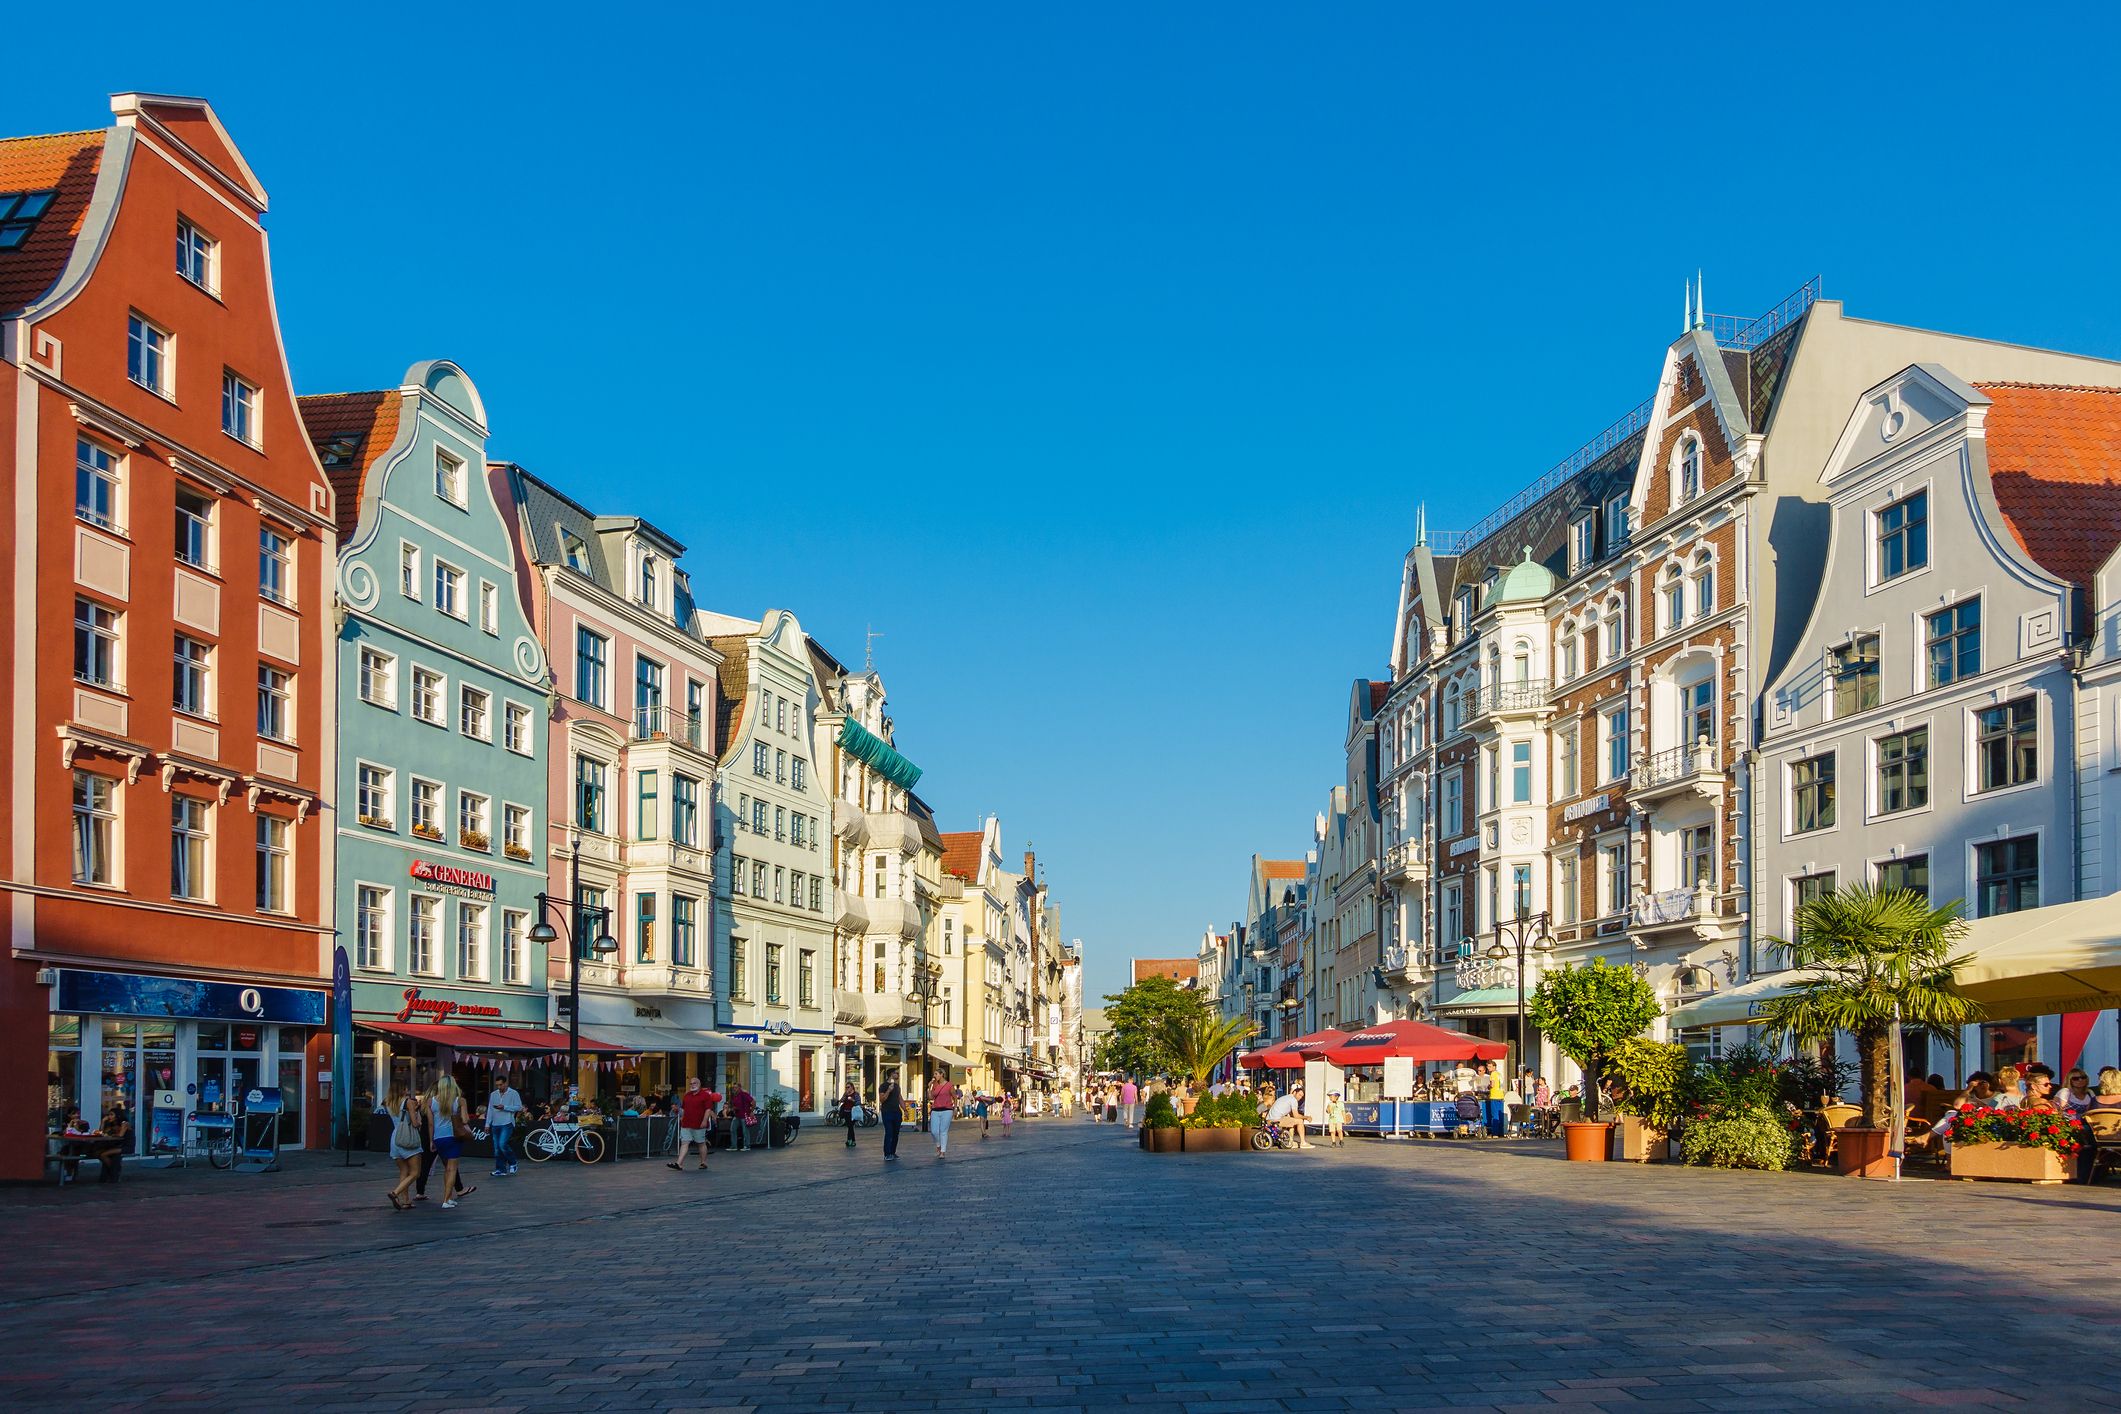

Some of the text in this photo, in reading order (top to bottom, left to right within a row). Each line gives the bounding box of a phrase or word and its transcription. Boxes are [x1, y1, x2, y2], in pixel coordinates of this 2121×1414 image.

[434, 864, 493, 891] GENERALI
[241, 988, 265, 1017] O2
[396, 987, 457, 1024] Junge
[634, 1007, 662, 1019] BONITA
